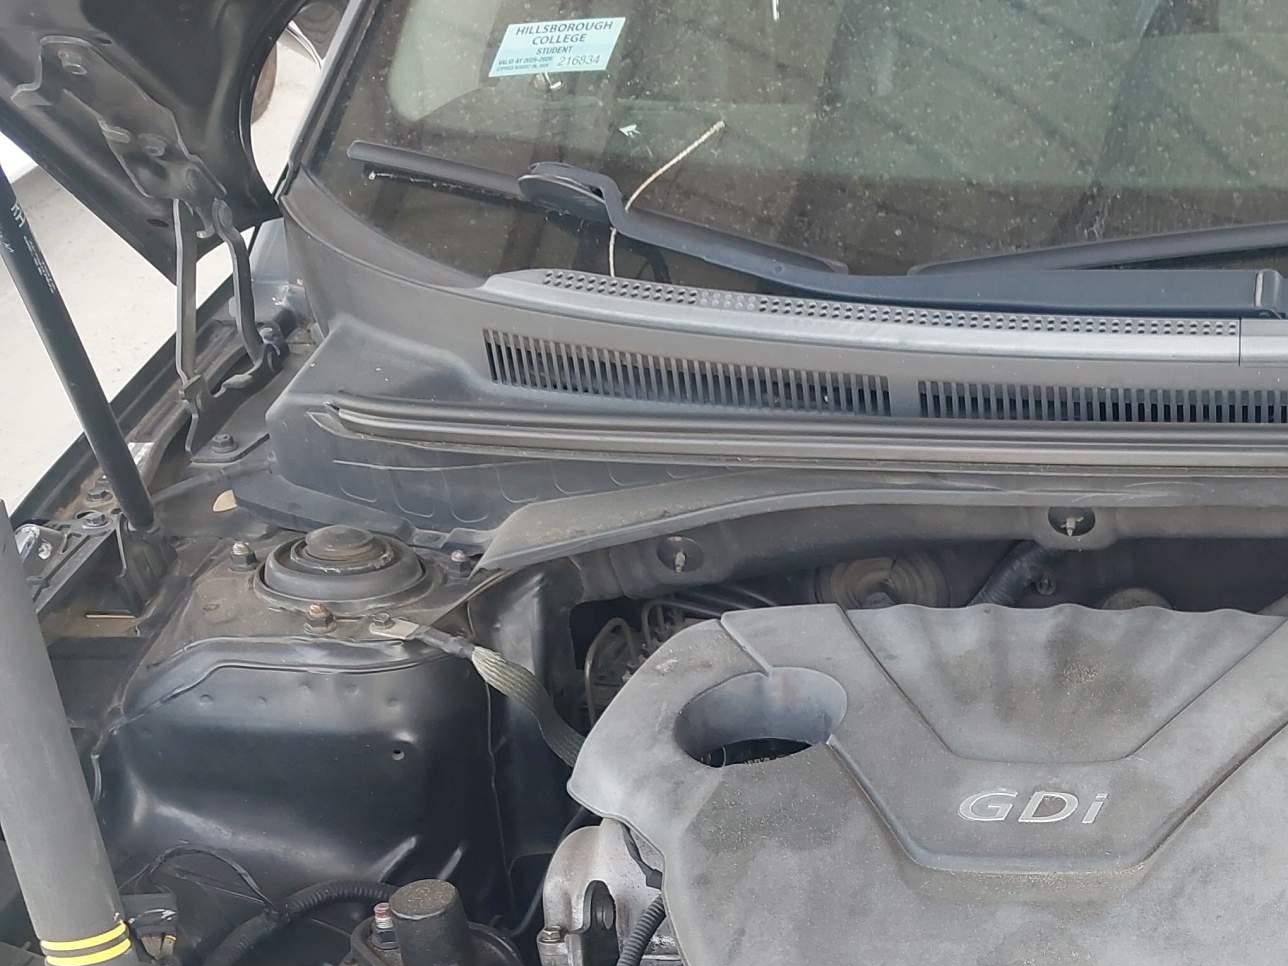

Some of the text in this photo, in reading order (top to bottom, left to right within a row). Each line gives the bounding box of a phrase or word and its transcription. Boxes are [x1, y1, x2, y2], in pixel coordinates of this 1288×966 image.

[515, 21, 613, 35] HILLSBOROUGH
[532, 34, 587, 45] COLLEGE
[536, 46, 573, 55] STUDENT
[958, 791, 1111, 824] GDi
